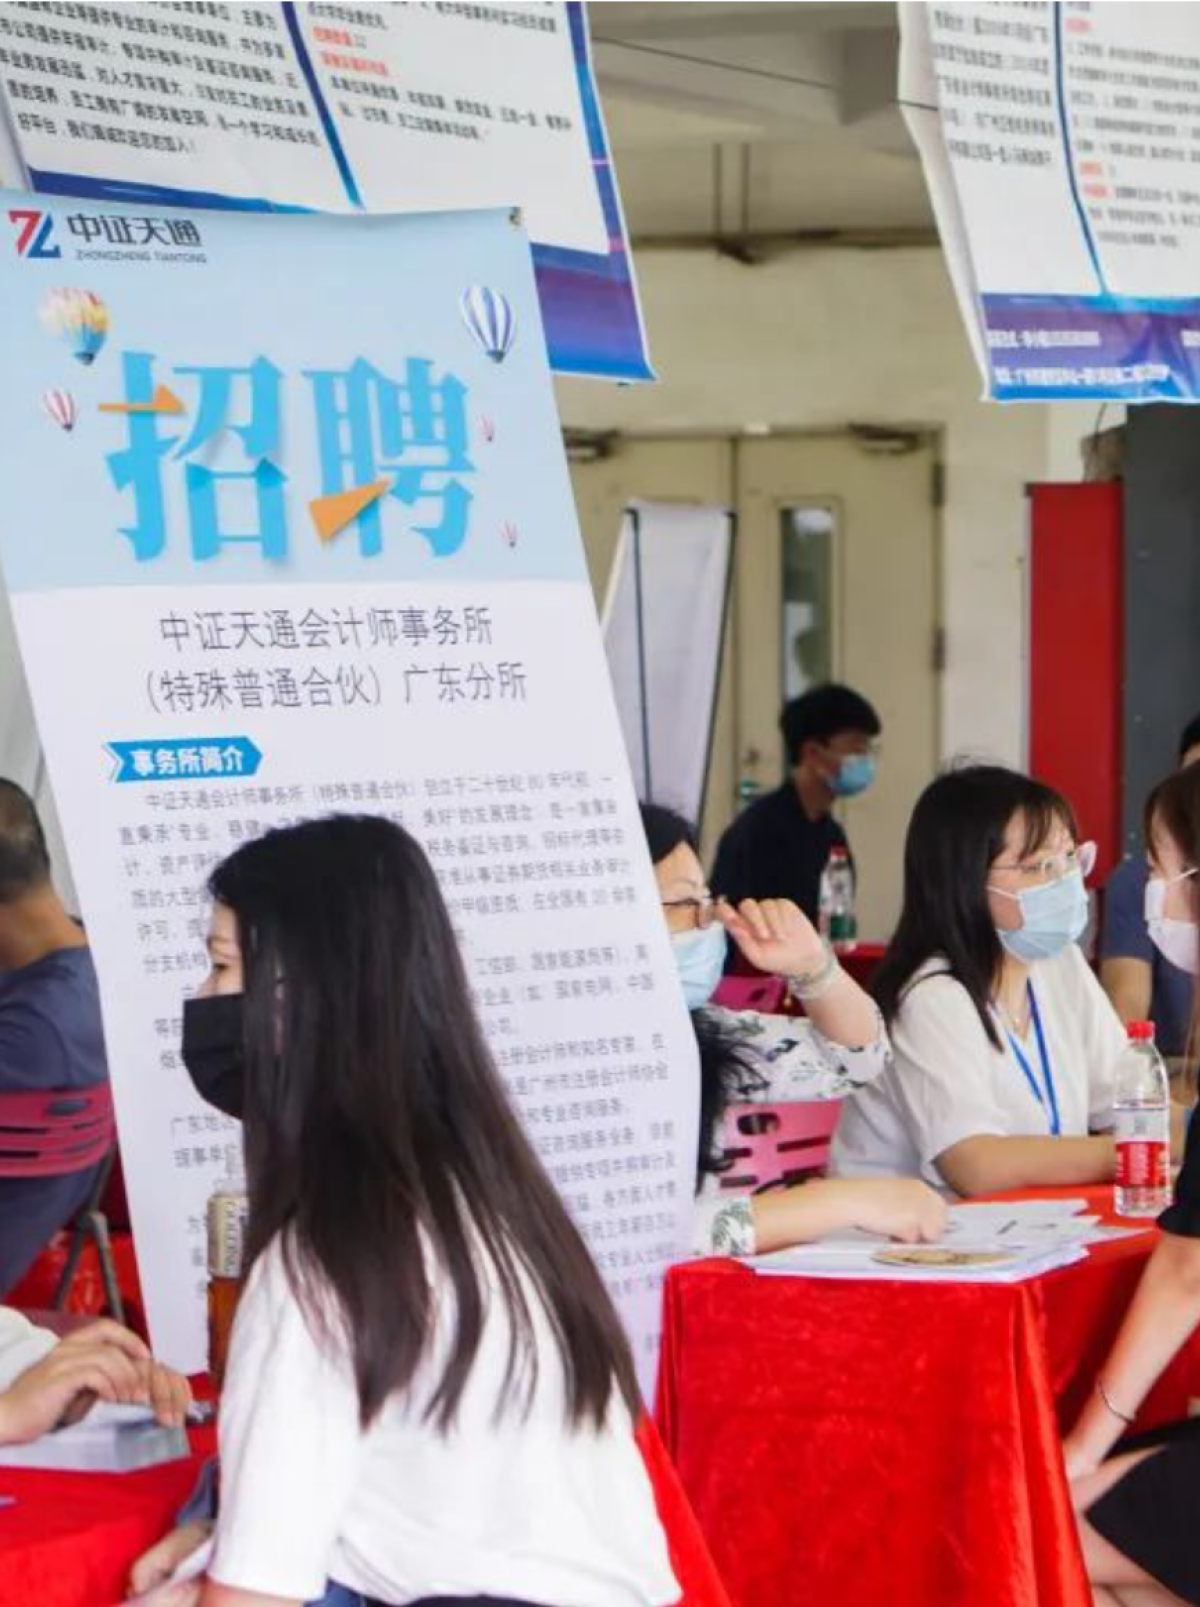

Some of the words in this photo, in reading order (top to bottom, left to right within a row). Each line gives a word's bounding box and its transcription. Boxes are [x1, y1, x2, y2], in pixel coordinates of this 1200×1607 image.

[67, 213, 203, 247] 中证天通
[75, 248, 152, 262] ZHONGZHENG
[154, 251, 207, 264] TIANTONG
[104, 350, 477, 563] 招聘
[159, 606, 493, 652] 中证天通会计师事务所
[130, 745, 244, 776] 事务所简介
